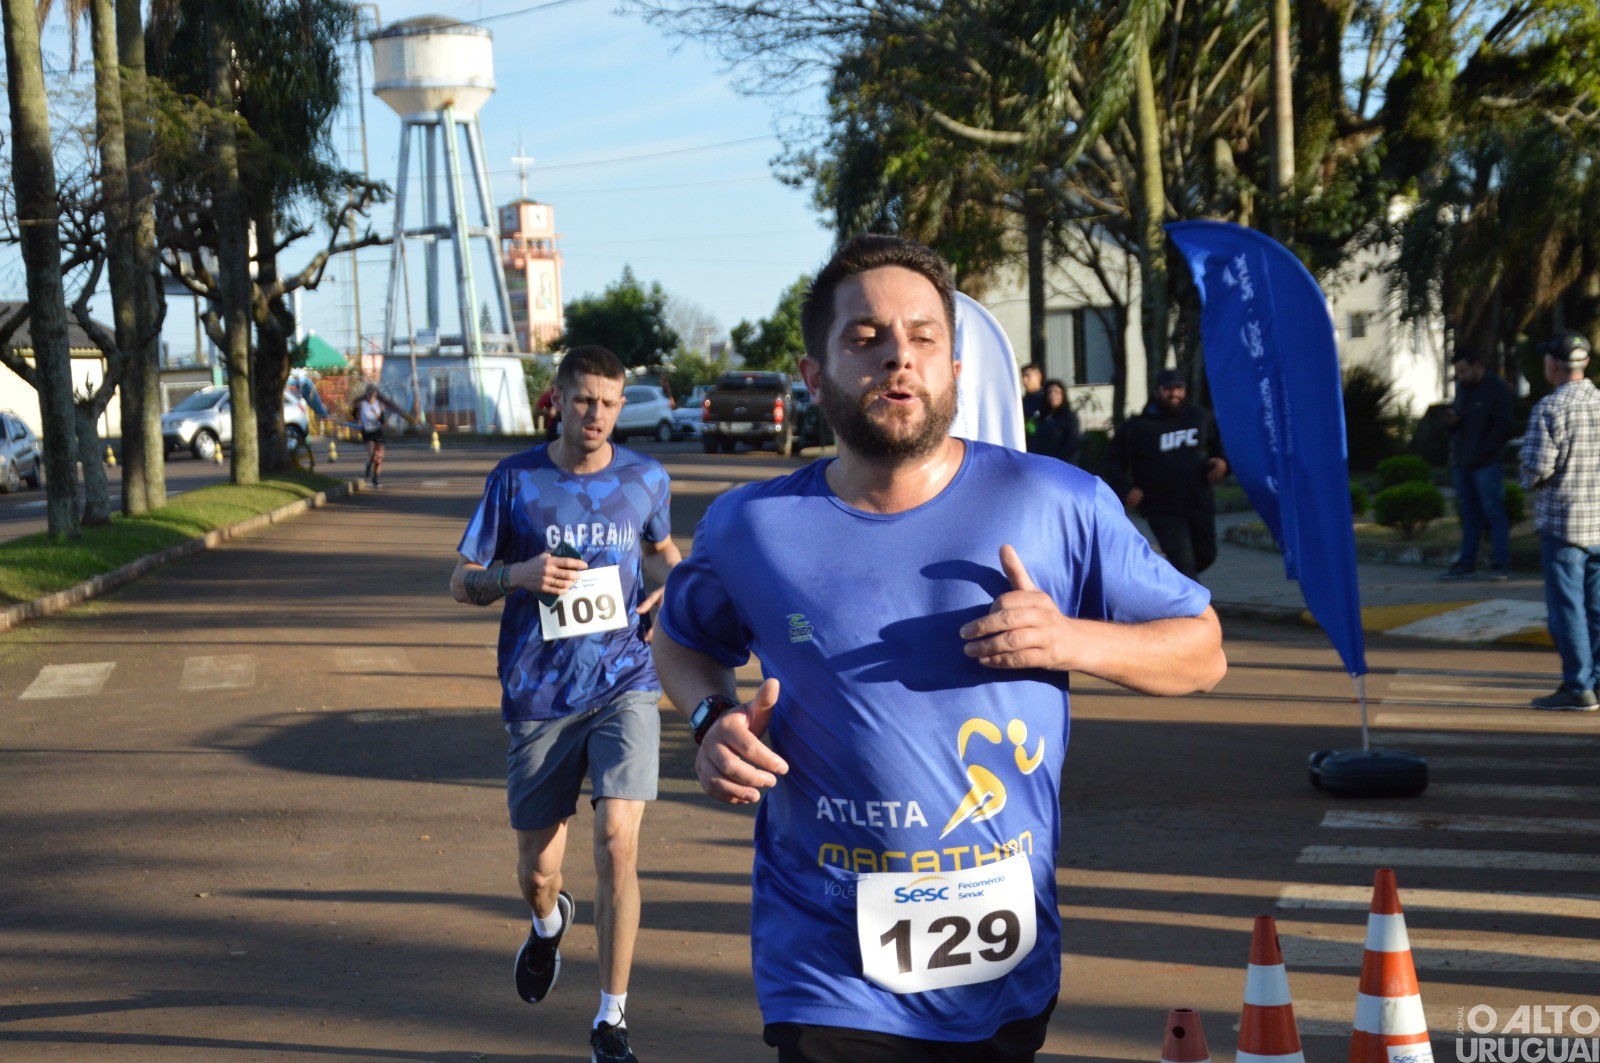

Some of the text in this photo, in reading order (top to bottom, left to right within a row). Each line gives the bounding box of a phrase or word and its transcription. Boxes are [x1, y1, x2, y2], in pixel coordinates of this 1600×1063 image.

[1160, 428, 1199, 451] UFC
[550, 593, 617, 627] 109
[816, 795, 929, 828] ATLETA
[894, 875, 1006, 904] Sesc Fecomércio
[879, 908, 1021, 975] 129
